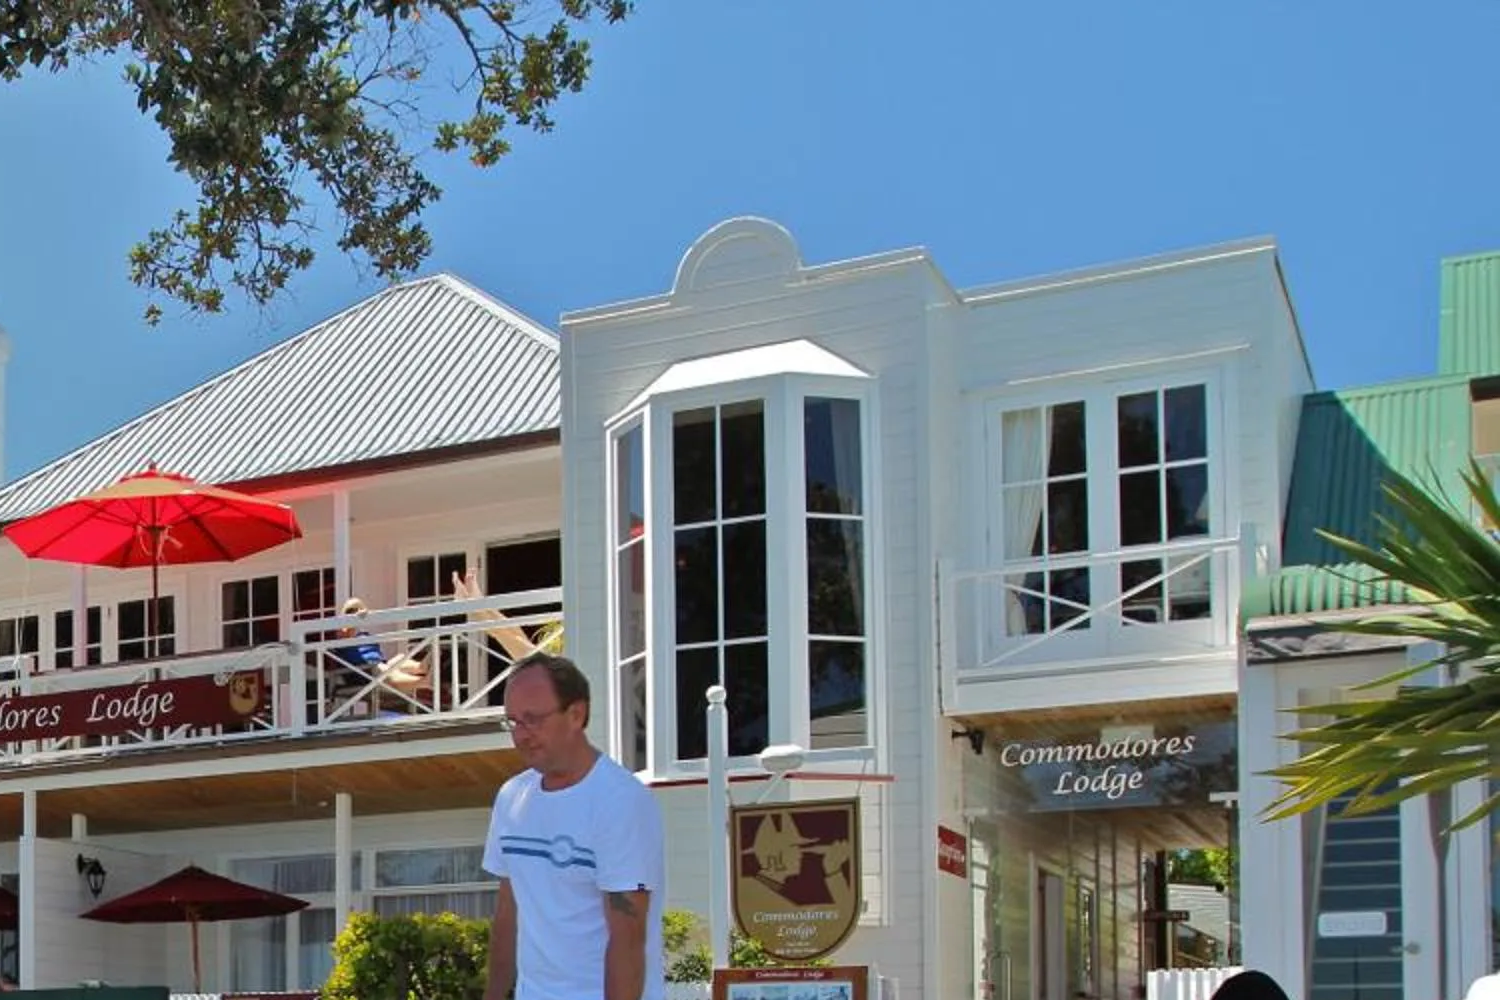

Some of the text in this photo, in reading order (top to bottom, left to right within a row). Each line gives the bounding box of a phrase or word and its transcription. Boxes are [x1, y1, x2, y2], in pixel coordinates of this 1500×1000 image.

[86, 685, 173, 726] Lodge
[1001, 734, 1196, 767] Commodores
[1053, 766, 1143, 799] Lodge
[753, 911, 838, 923] Commodores
